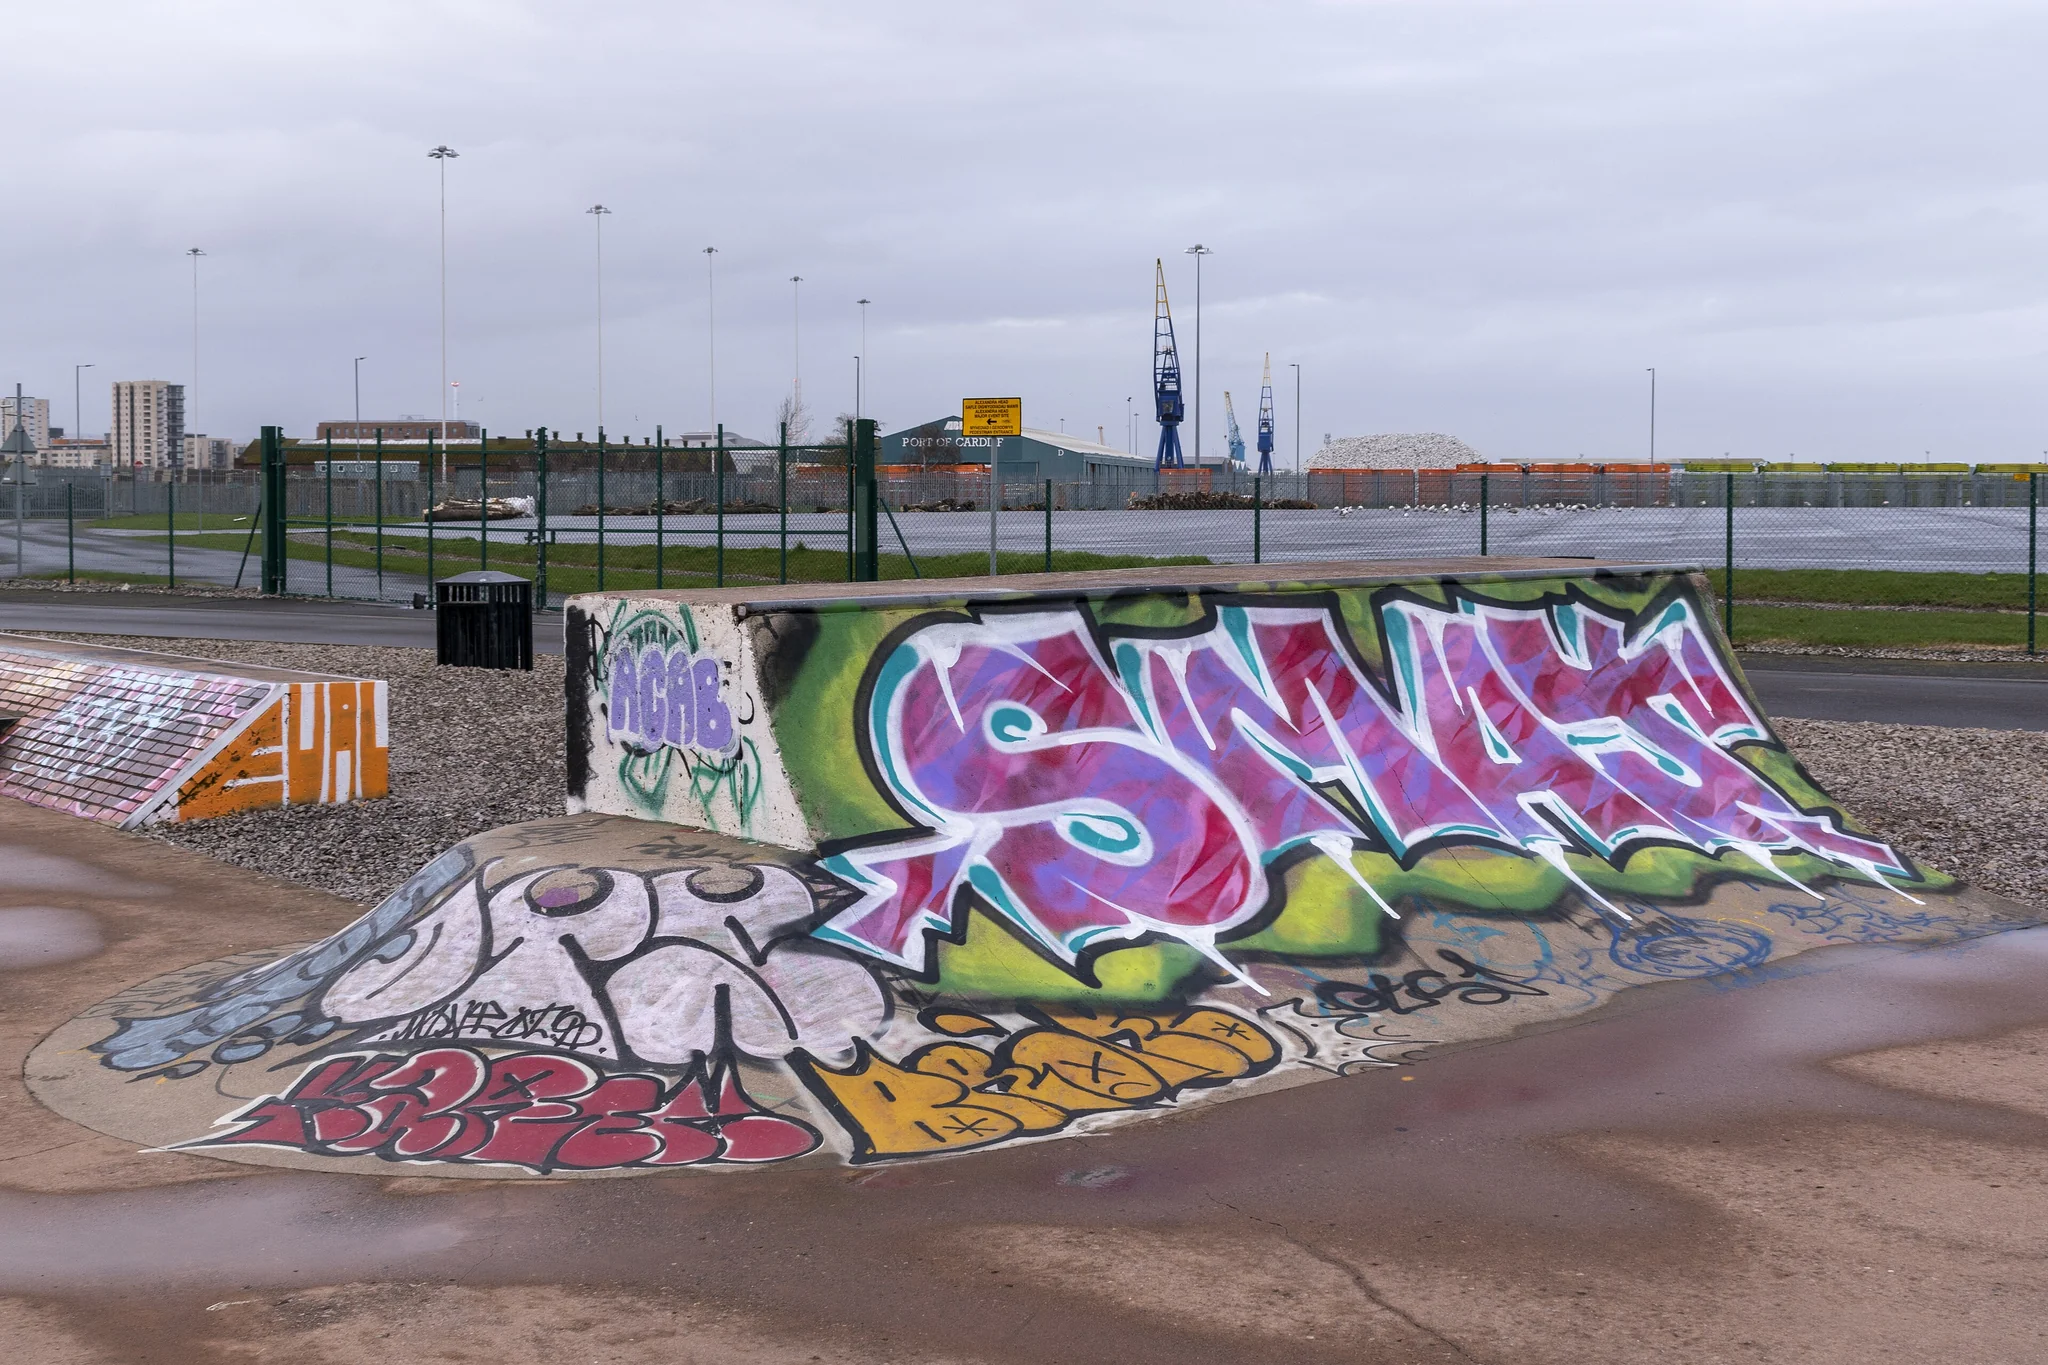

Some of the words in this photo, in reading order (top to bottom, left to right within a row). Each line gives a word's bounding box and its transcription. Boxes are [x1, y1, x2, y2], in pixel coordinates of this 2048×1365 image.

[902, 437, 933, 447] PORT
[936, 437, 952, 447] OF
[955, 437, 1004, 447] CARDIF
[609, 642, 738, 756] ACAB
